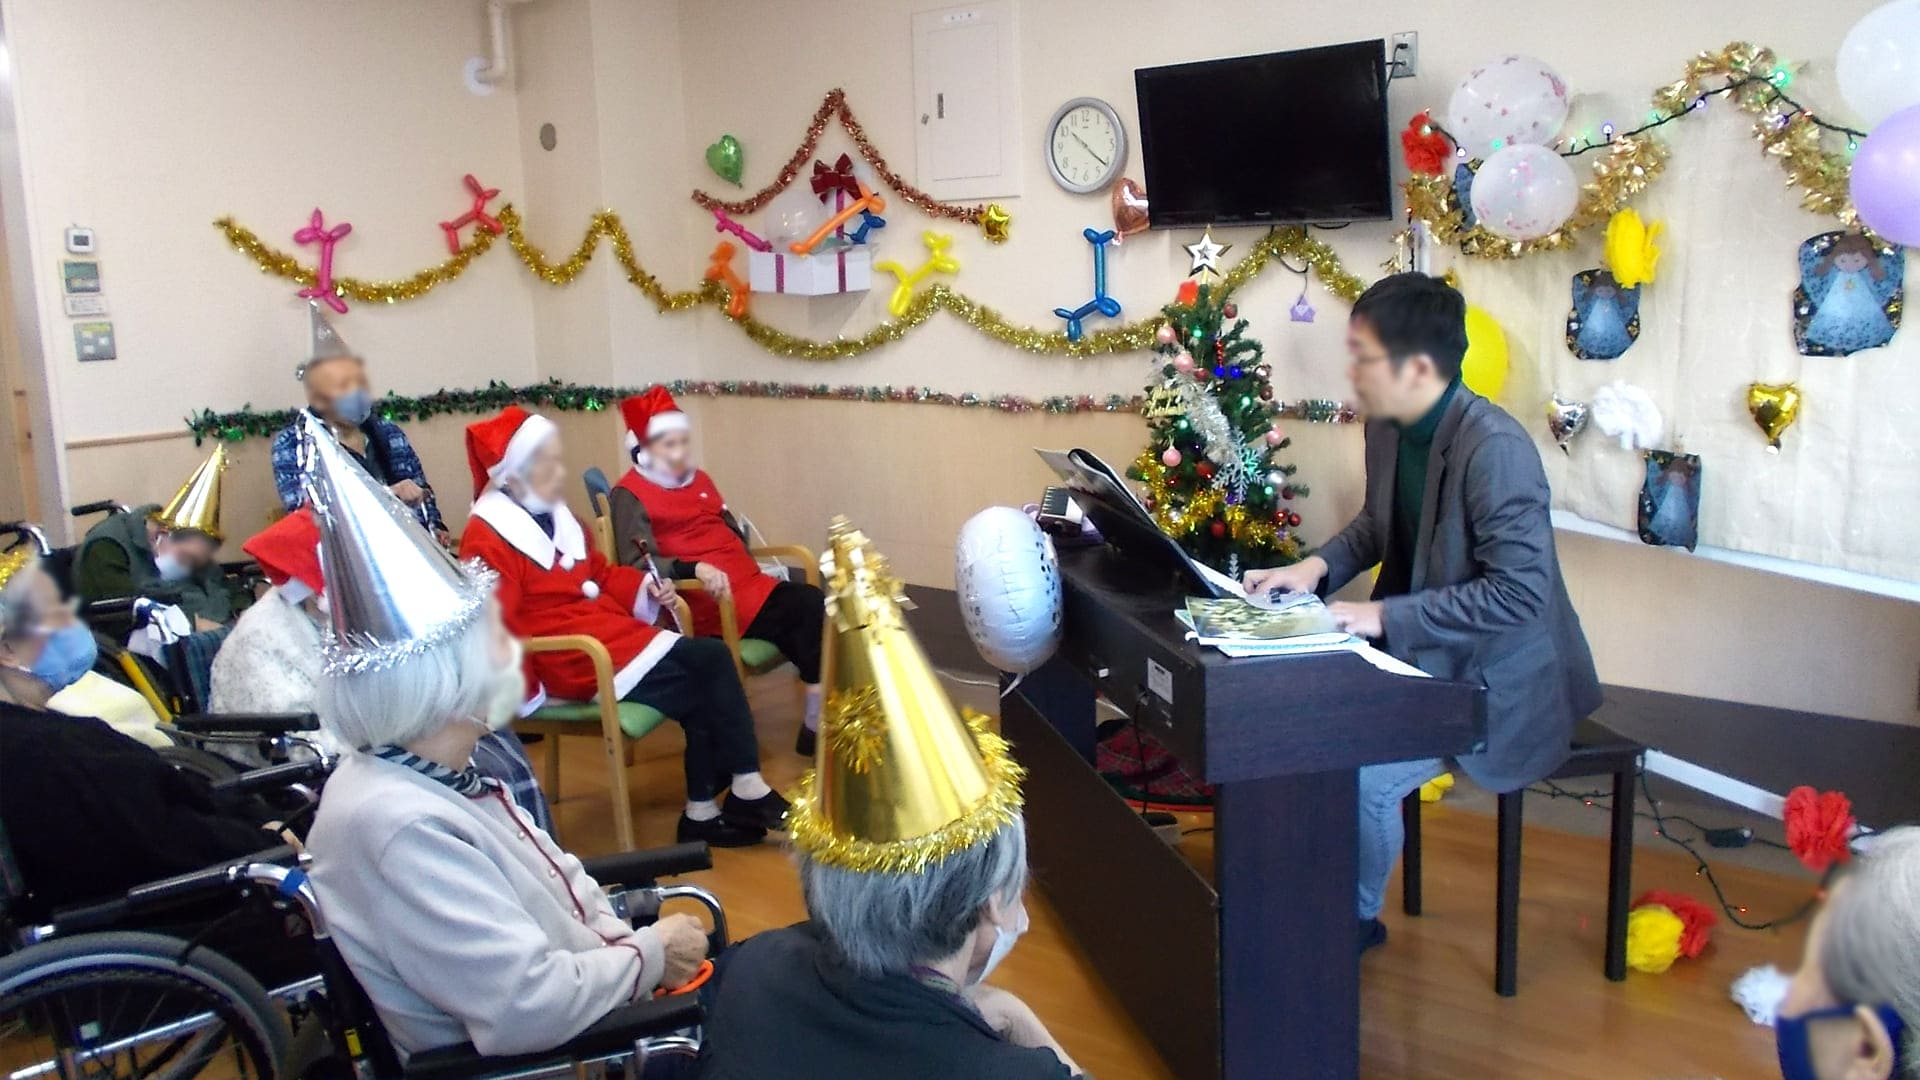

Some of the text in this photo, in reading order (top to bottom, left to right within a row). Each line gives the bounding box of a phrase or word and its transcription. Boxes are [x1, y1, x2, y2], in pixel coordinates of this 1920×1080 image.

[1070, 114, 1078, 126] 11
[1081, 110, 1090, 122] 12
[1060, 125, 1069, 137] 10
[1062, 157, 1069, 169] 8
[1072, 167, 1078, 179] 7
[1082, 169, 1089, 181] 6
